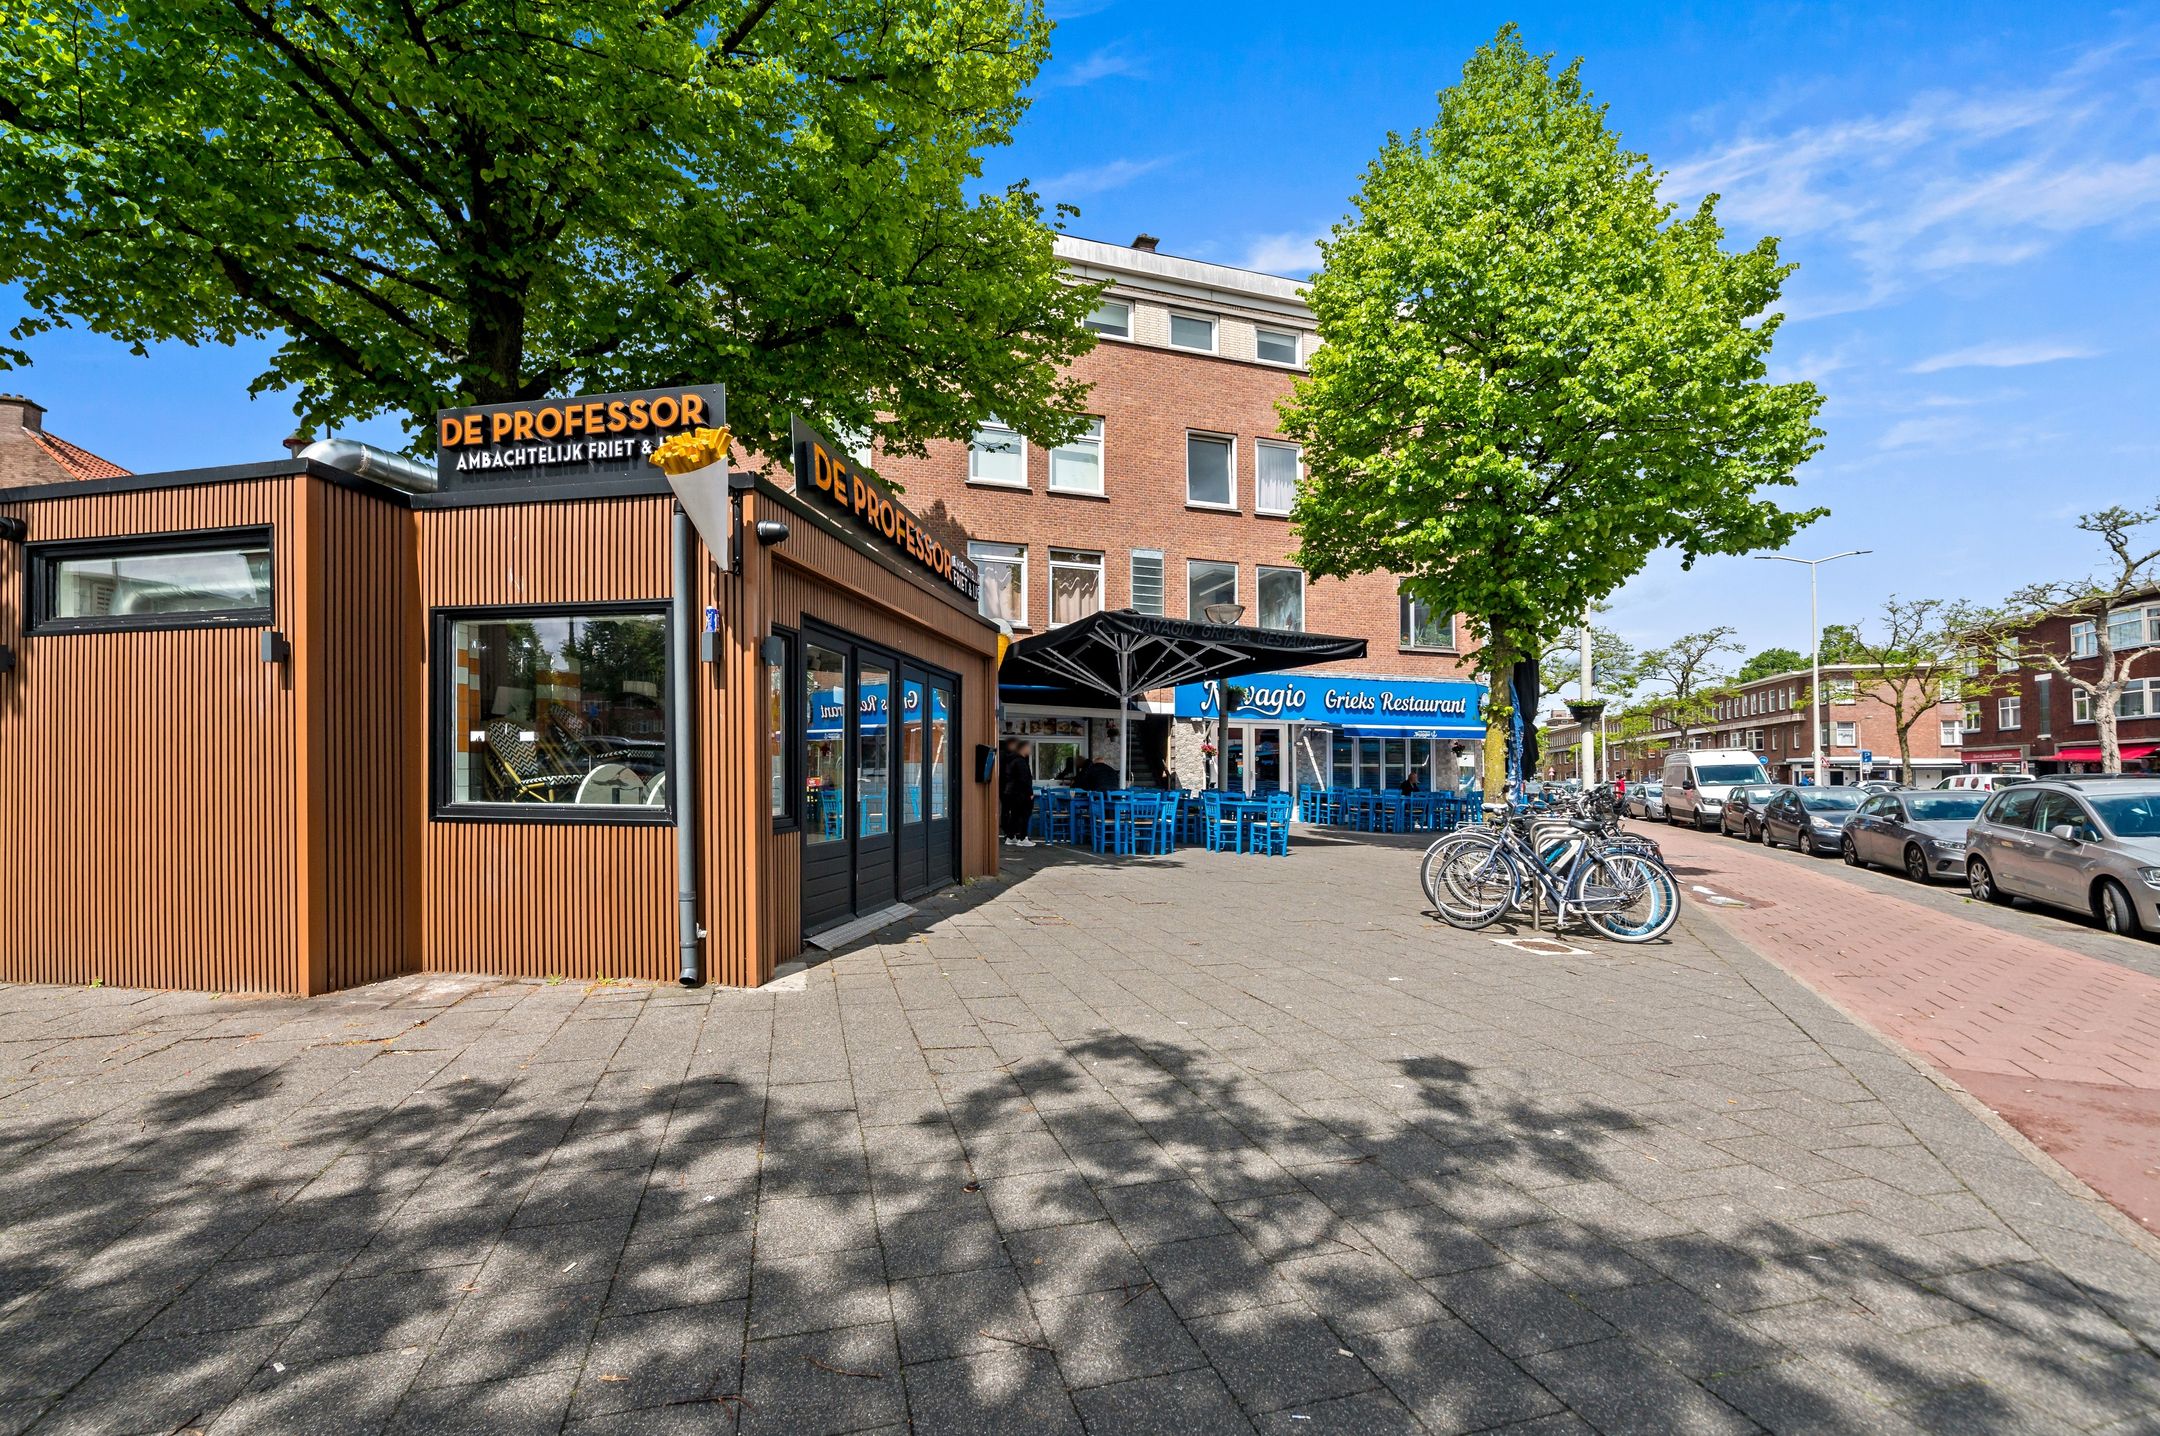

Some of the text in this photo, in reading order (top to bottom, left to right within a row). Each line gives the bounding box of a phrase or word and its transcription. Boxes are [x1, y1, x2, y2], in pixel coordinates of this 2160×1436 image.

[441, 394, 704, 447] DE PROFESSOR
[456, 443, 583, 471] AMBACHTELIJK
[588, 439, 635, 459] FRIET
[641, 440, 652, 455] &
[813, 442, 952, 582] DE PROFESSOR
[953, 569, 968, 593] FRIET
[1132, 617, 1195, 636] NAVAGIO
[1201, 624, 1250, 642] GRIEKS
[1201, 680, 1466, 716] Nvagio Grieks Restaurant
